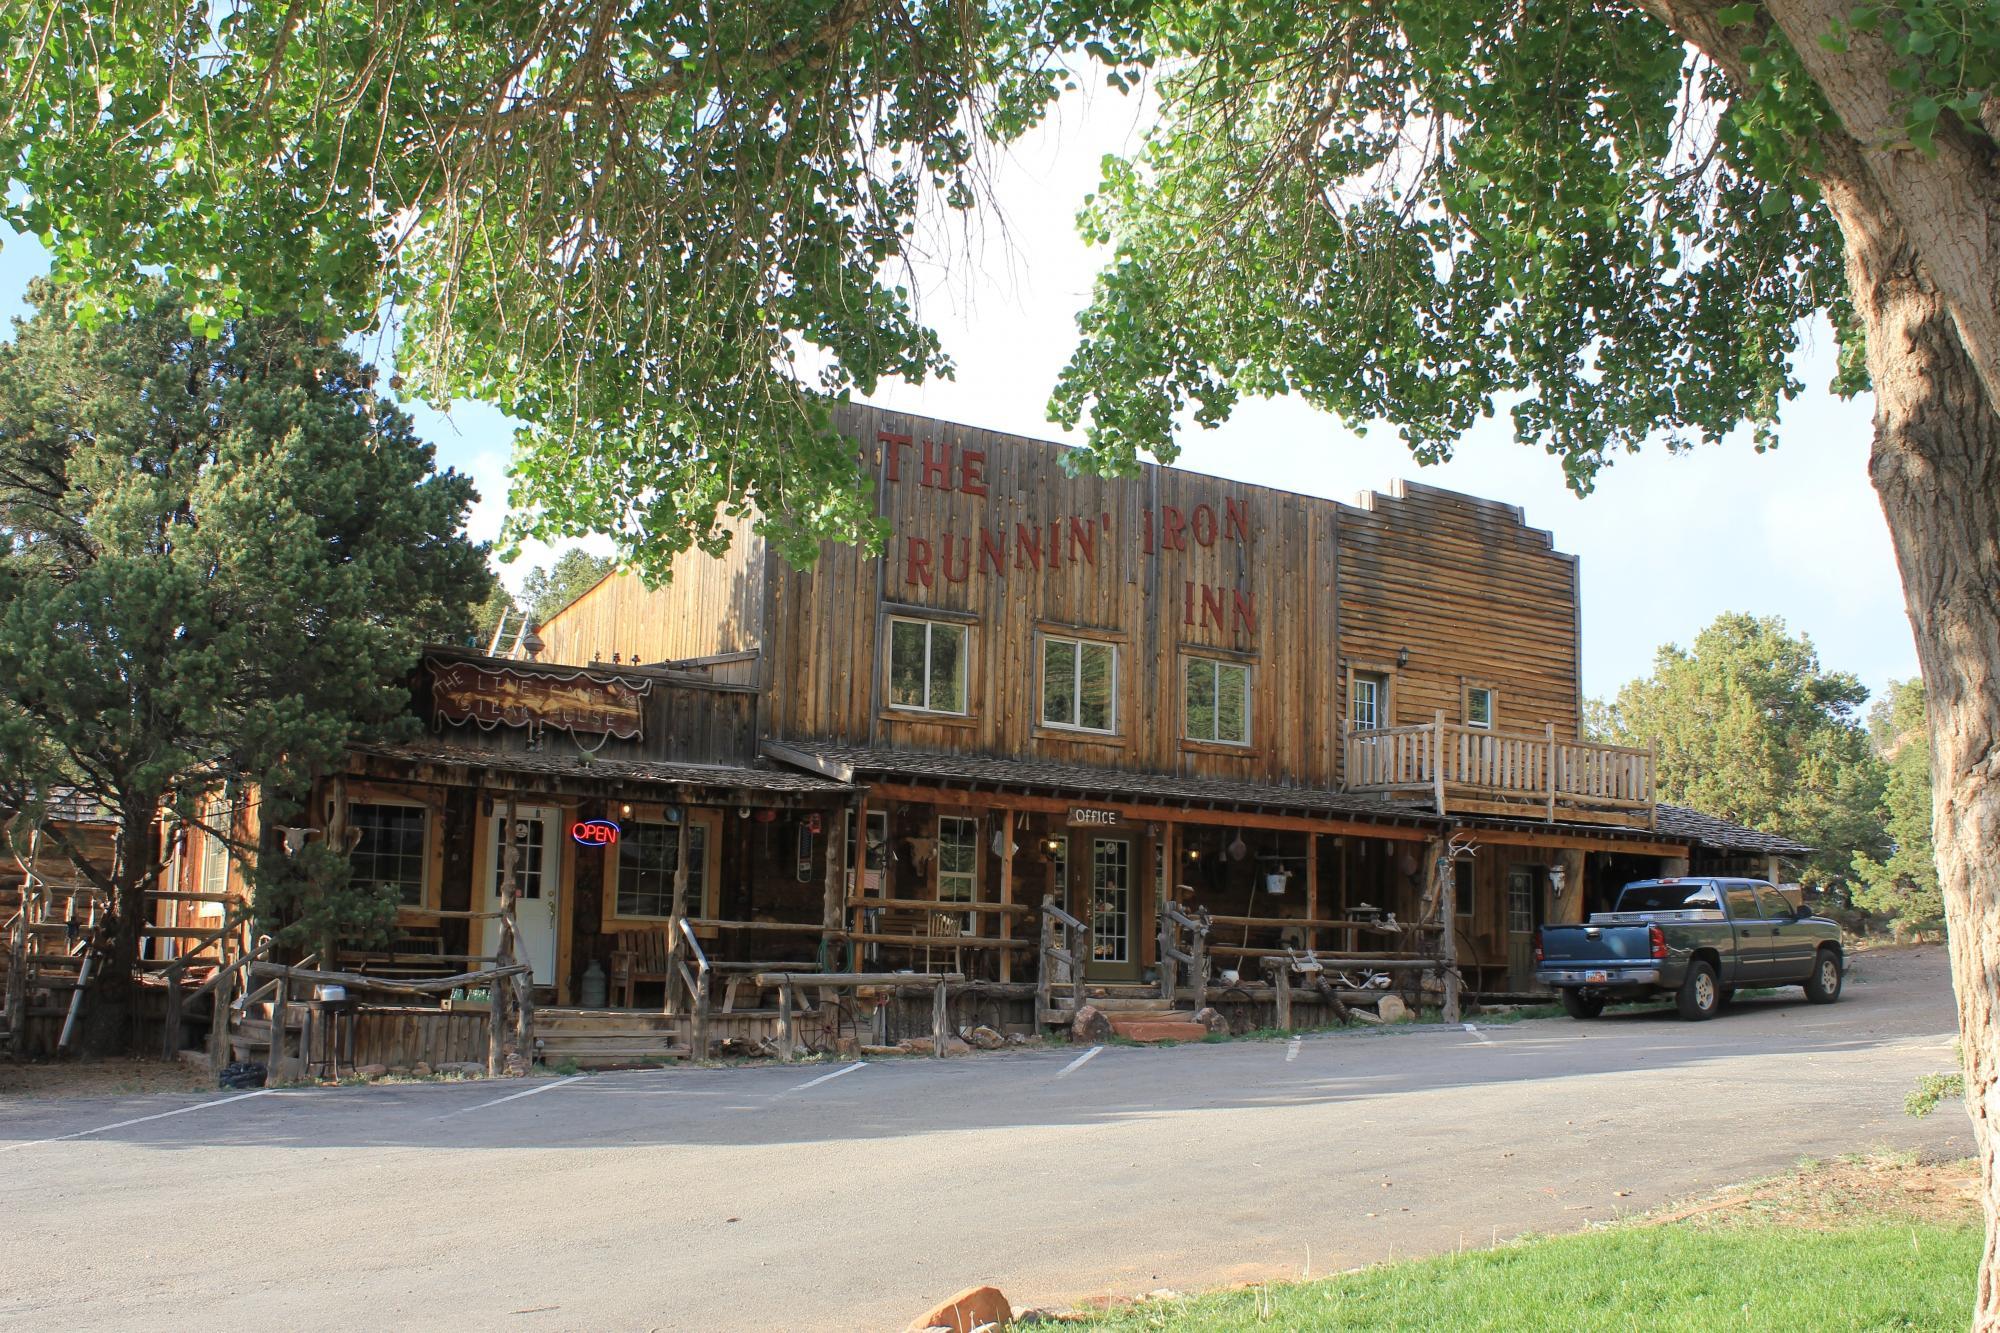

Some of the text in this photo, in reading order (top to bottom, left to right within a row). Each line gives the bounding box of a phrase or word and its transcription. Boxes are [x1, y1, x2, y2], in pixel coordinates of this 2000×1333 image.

[877, 430, 990, 498] THE
[905, 496, 1249, 587] RUNNIN' IRON
[1183, 580, 1256, 635] INN
[434, 670, 464, 695] THE
[572, 822, 617, 844] OPEN
